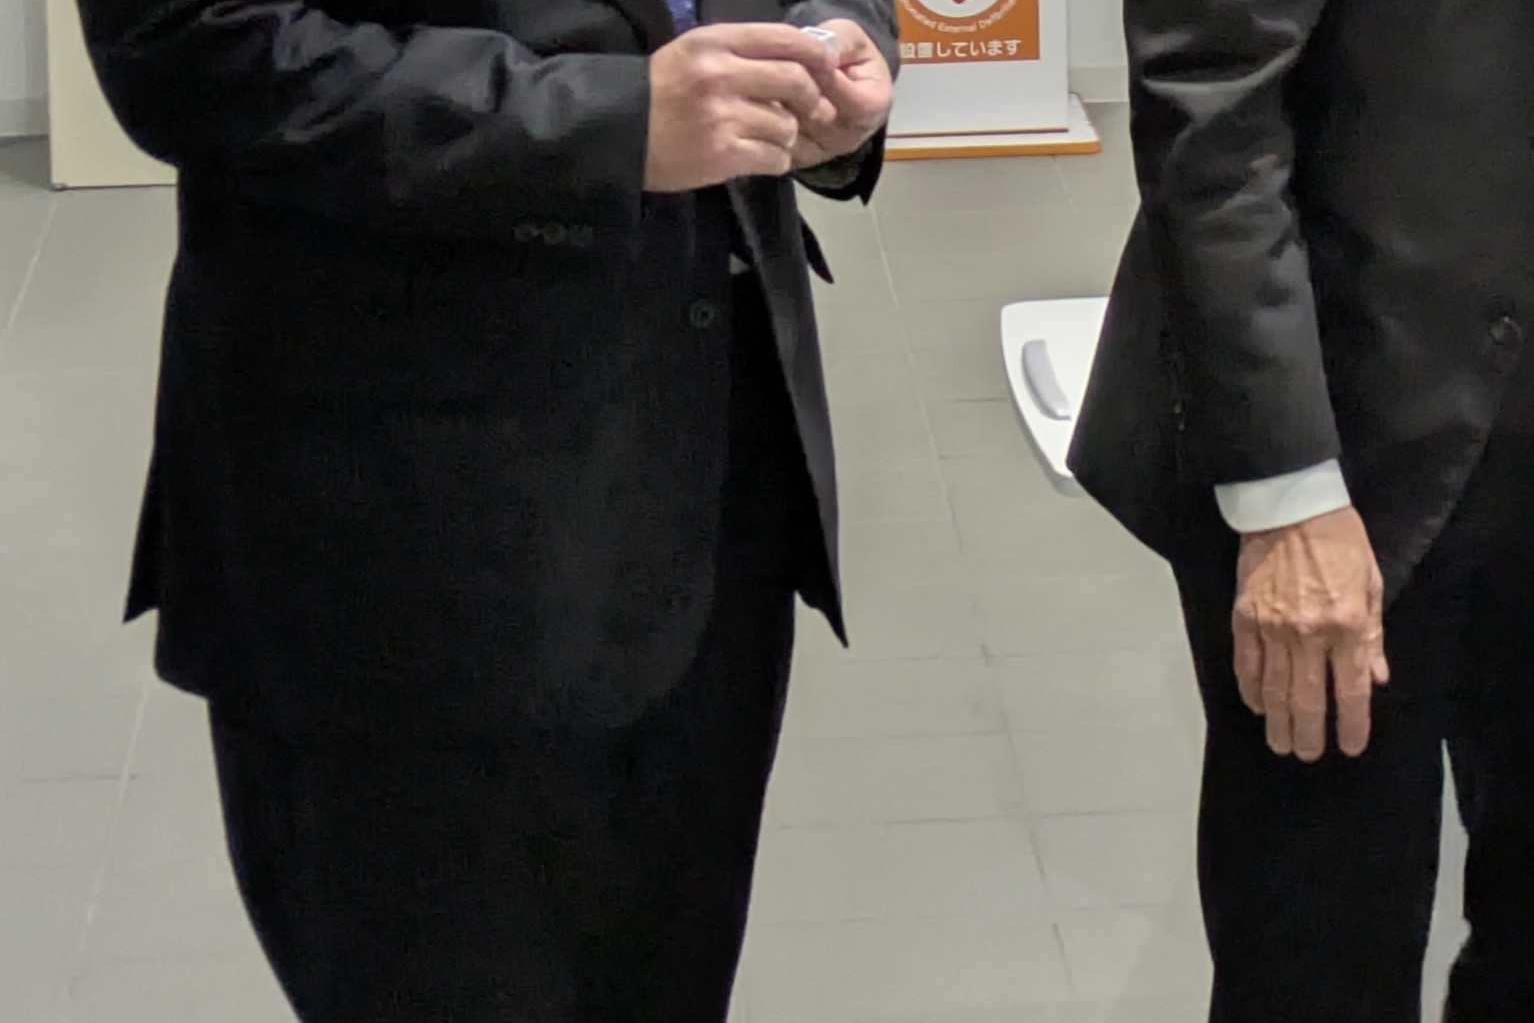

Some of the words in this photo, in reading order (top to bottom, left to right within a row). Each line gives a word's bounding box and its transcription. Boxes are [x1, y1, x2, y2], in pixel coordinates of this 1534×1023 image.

[899, 38, 1022, 60] 設置しています
